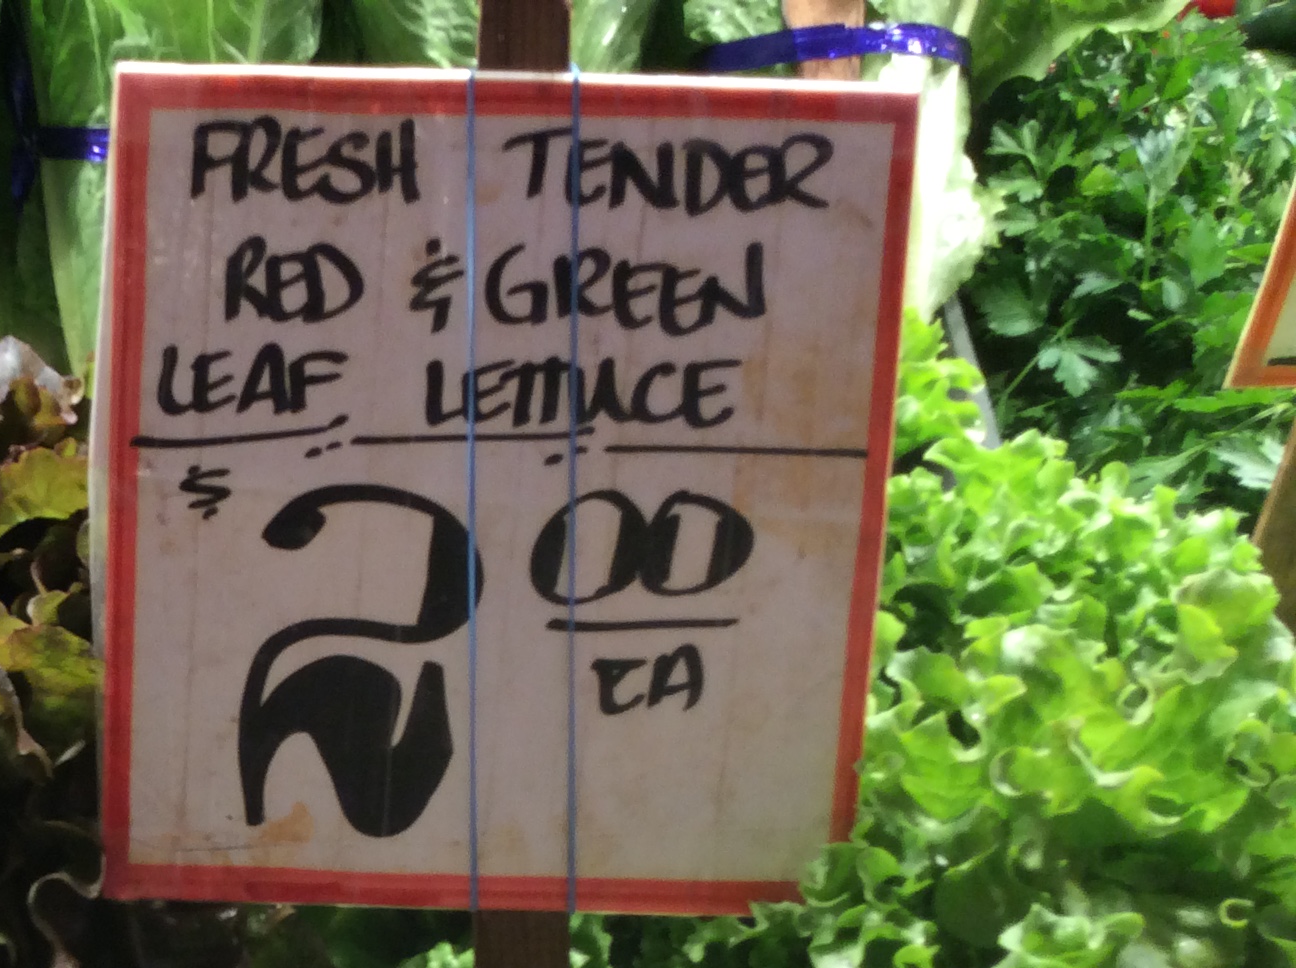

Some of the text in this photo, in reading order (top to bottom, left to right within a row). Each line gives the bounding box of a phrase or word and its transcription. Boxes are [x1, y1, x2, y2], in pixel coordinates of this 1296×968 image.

[190, 115, 834, 210] FRESH TENDER
[224, 237, 767, 336] RED & GREEN
[156, 342, 741, 429] LEAF LETTUCE
[592, 642, 704, 716] EA
